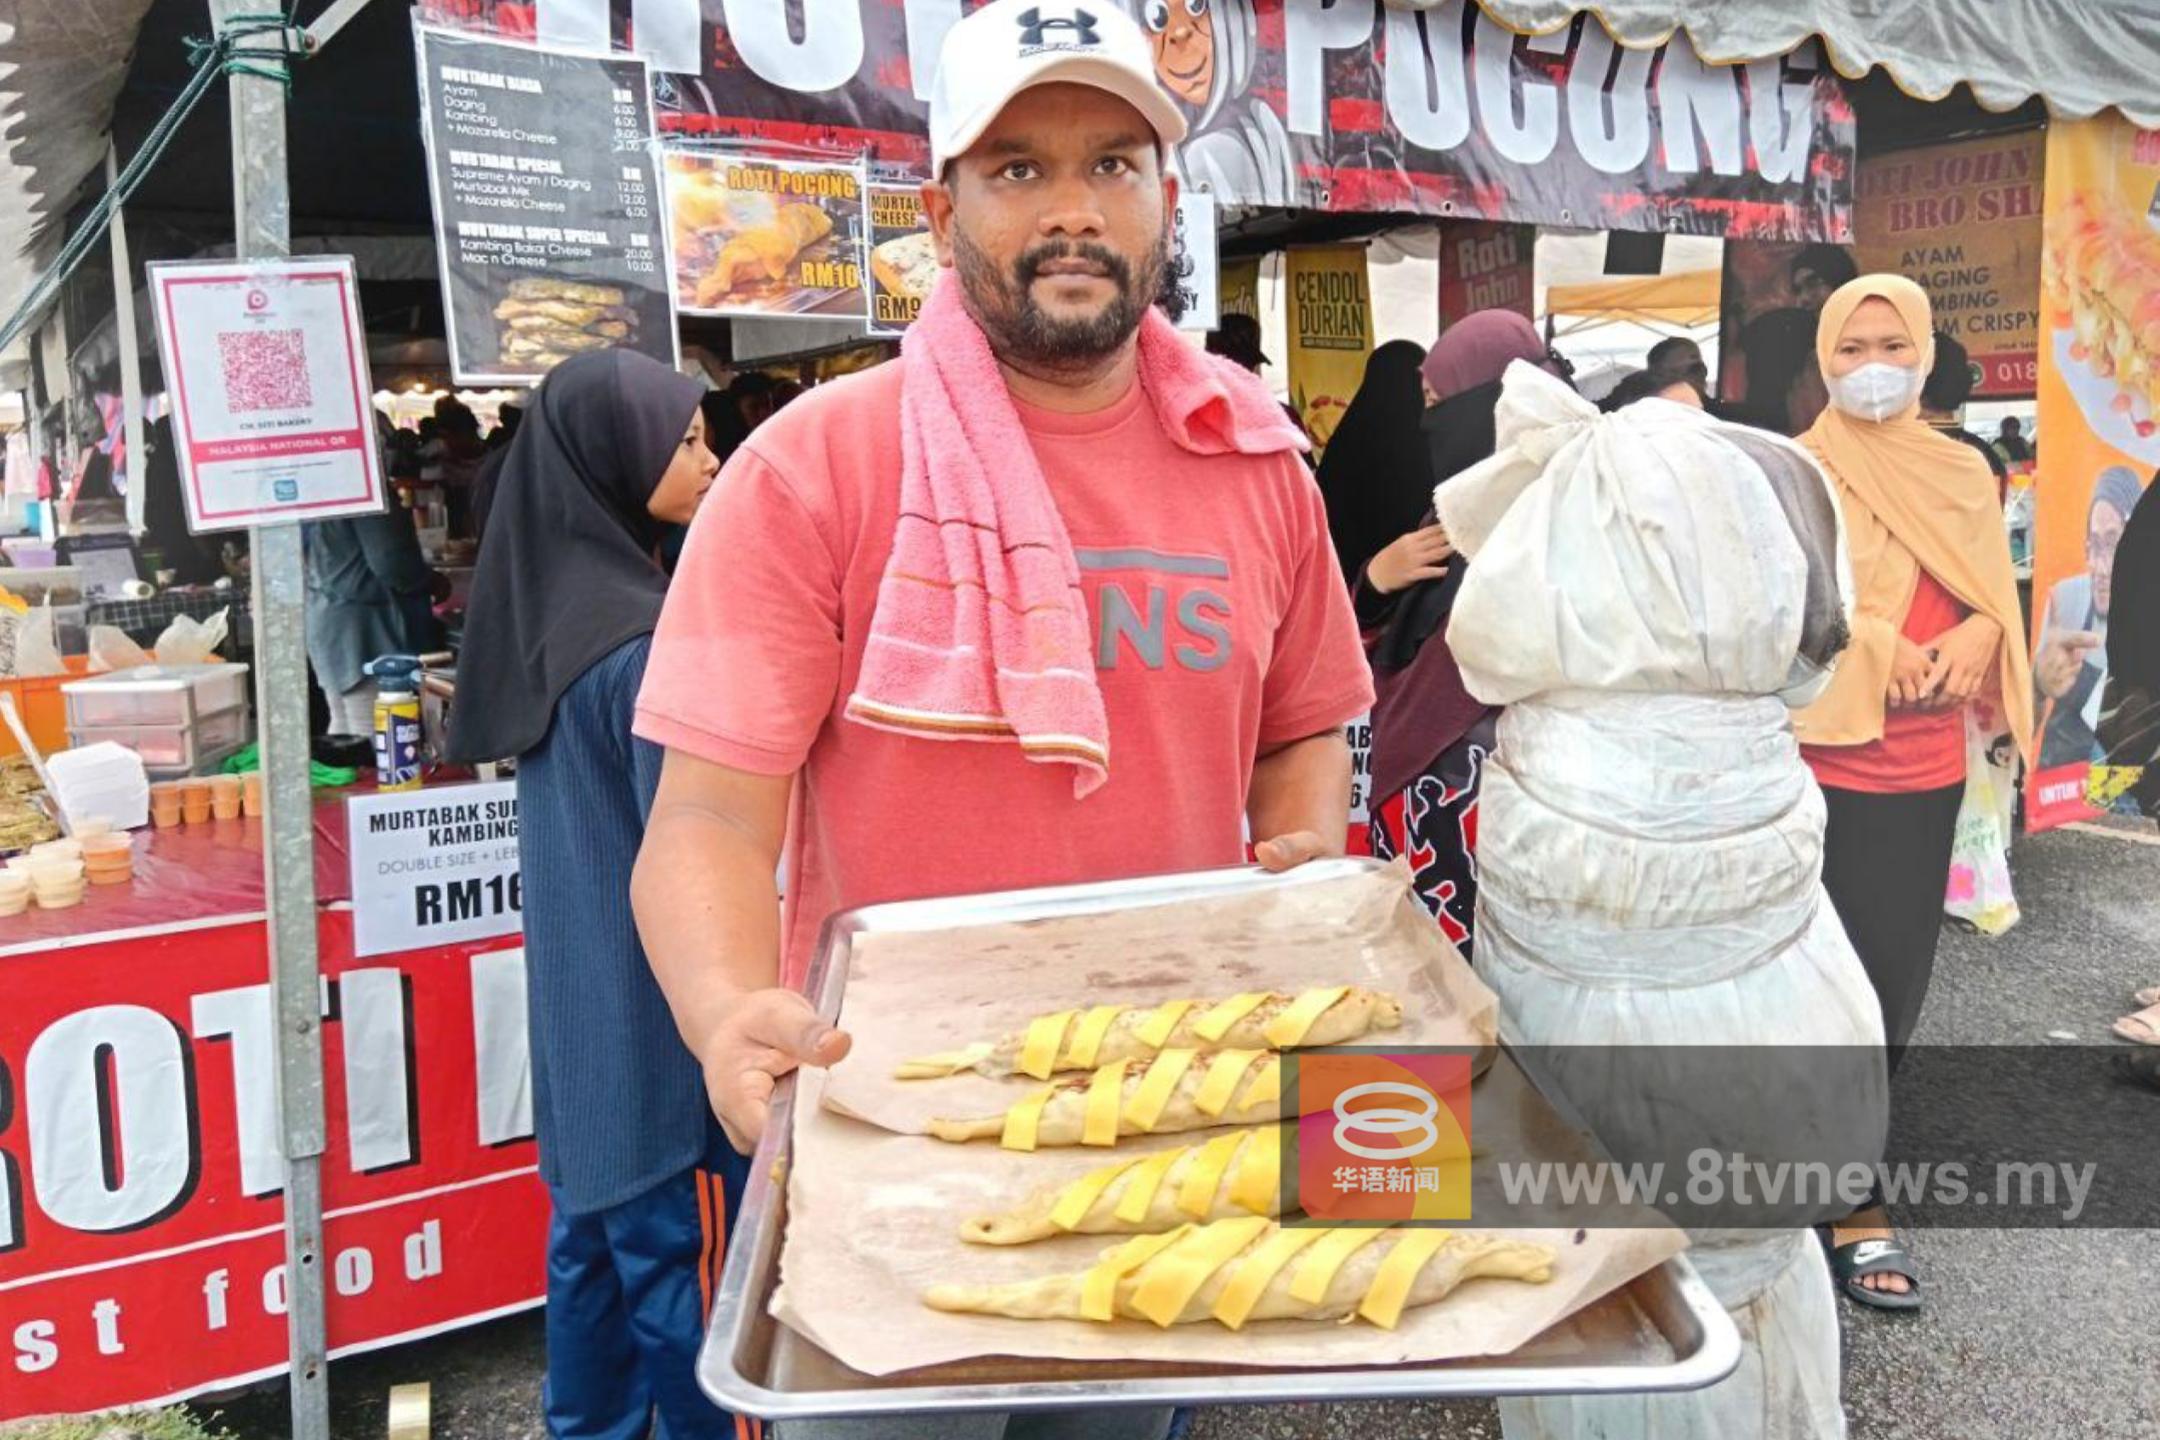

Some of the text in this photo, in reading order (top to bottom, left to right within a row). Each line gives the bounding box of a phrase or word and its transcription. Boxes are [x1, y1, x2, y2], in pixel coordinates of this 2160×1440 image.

[443, 84, 477, 97] Ayam
[512, 129, 557, 144] Cheese
[507, 173, 541, 185] Ayam
[728, 167, 775, 193] ROTI
[777, 171, 856, 198] POCONG
[521, 200, 566, 213] Cheese
[872, 210, 917, 226] CHEESE
[1890, 184, 2043, 232] BRO SH
[462, 252, 489, 264] Mac
[501, 253, 547, 267] Cheese
[548, 243, 592, 256] Cheese
[1901, 245, 1964, 268] AYAM
[801, 262, 859, 288] RM10
[1295, 271, 1365, 304] CENDOL
[1298, 304, 1365, 337] DURIAN
[1967, 311, 2040, 333] CRISPY
[270, 437, 328, 450] NATIONAL
[369, 802, 481, 834] MURTABAK
[428, 818, 519, 848] KAMBING
[377, 856, 446, 876] DOUBLE
[446, 850, 476, 868] SIZE
[0, 967, 412, 1248] OTI
